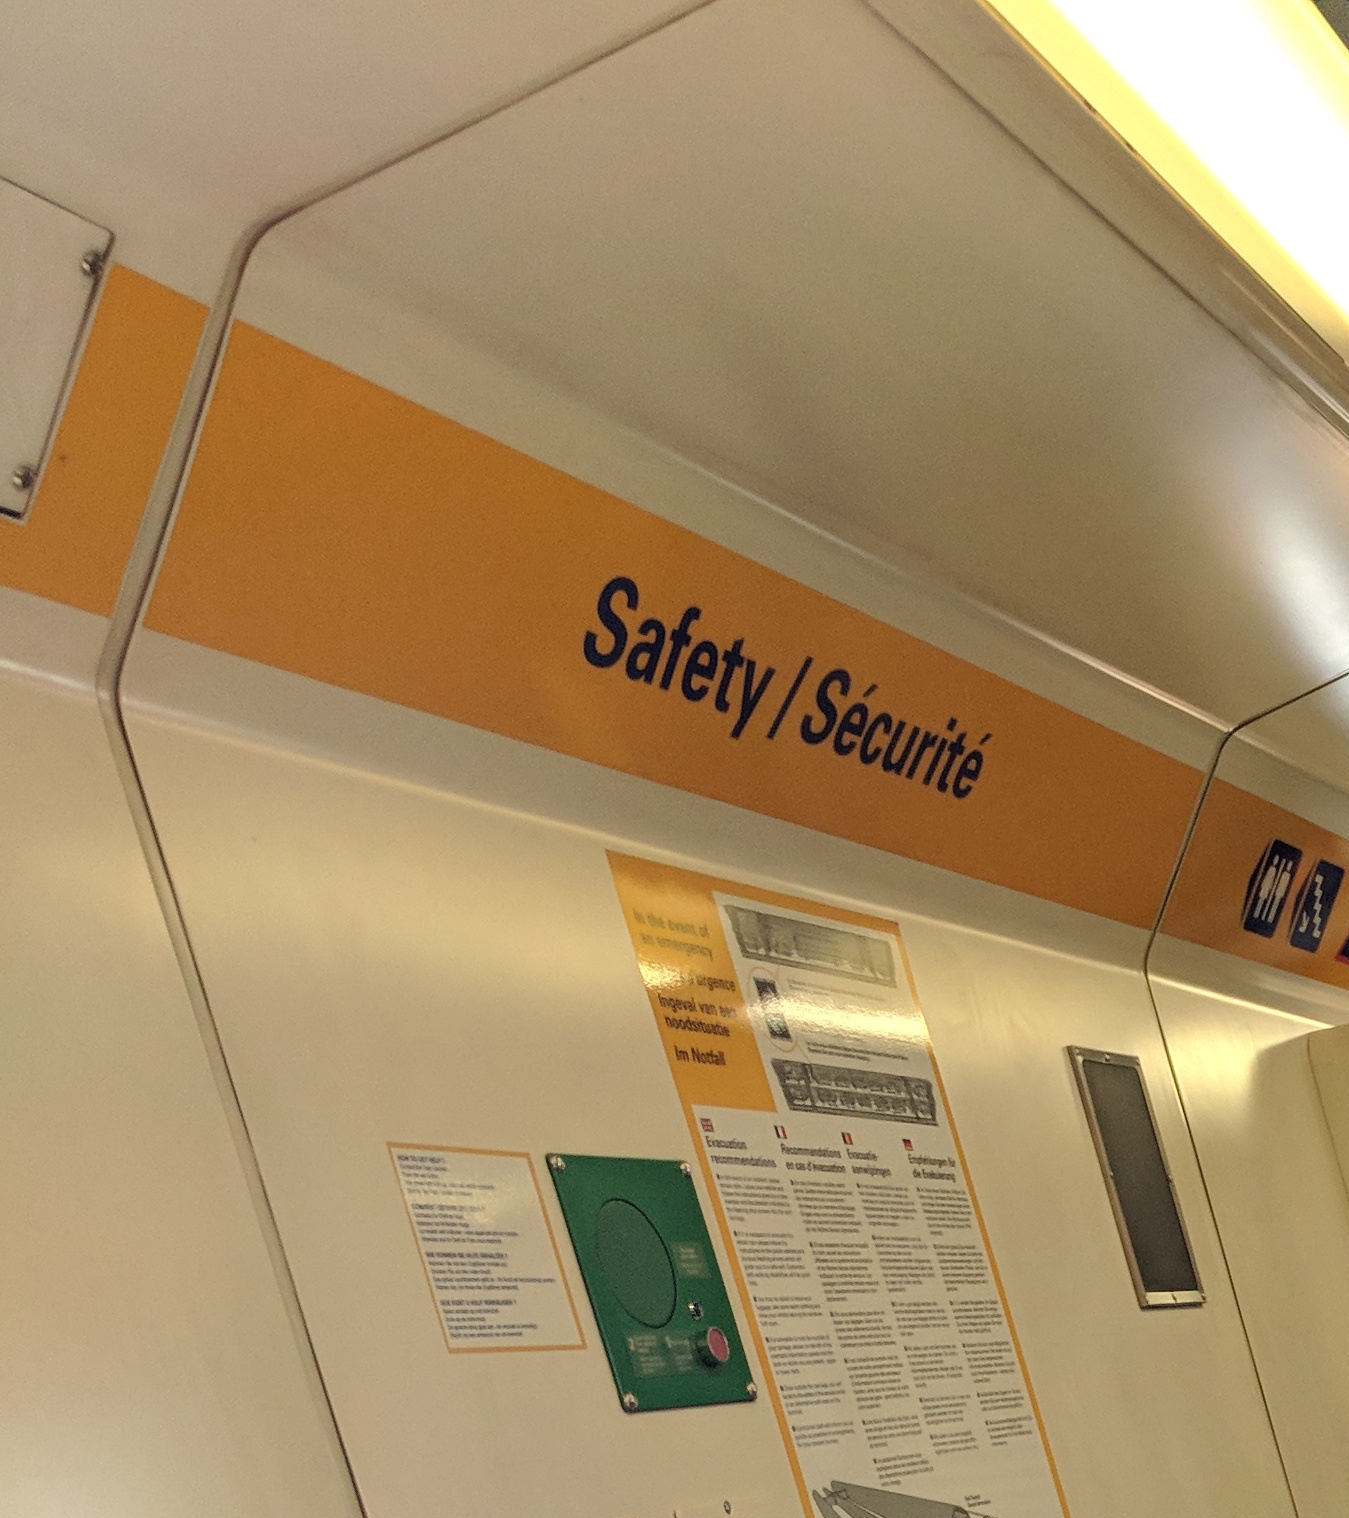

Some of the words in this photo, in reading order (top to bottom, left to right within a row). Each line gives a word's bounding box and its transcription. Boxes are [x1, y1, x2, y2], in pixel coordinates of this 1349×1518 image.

[583, 576, 776, 739] Safety
[767, 657, 813, 740] /
[800, 669, 994, 800] Sécurité
[674, 1045, 690, 1063] Im
[691, 1047, 727, 1067] Notfall
[705, 1135, 748, 1151] Evacuation
